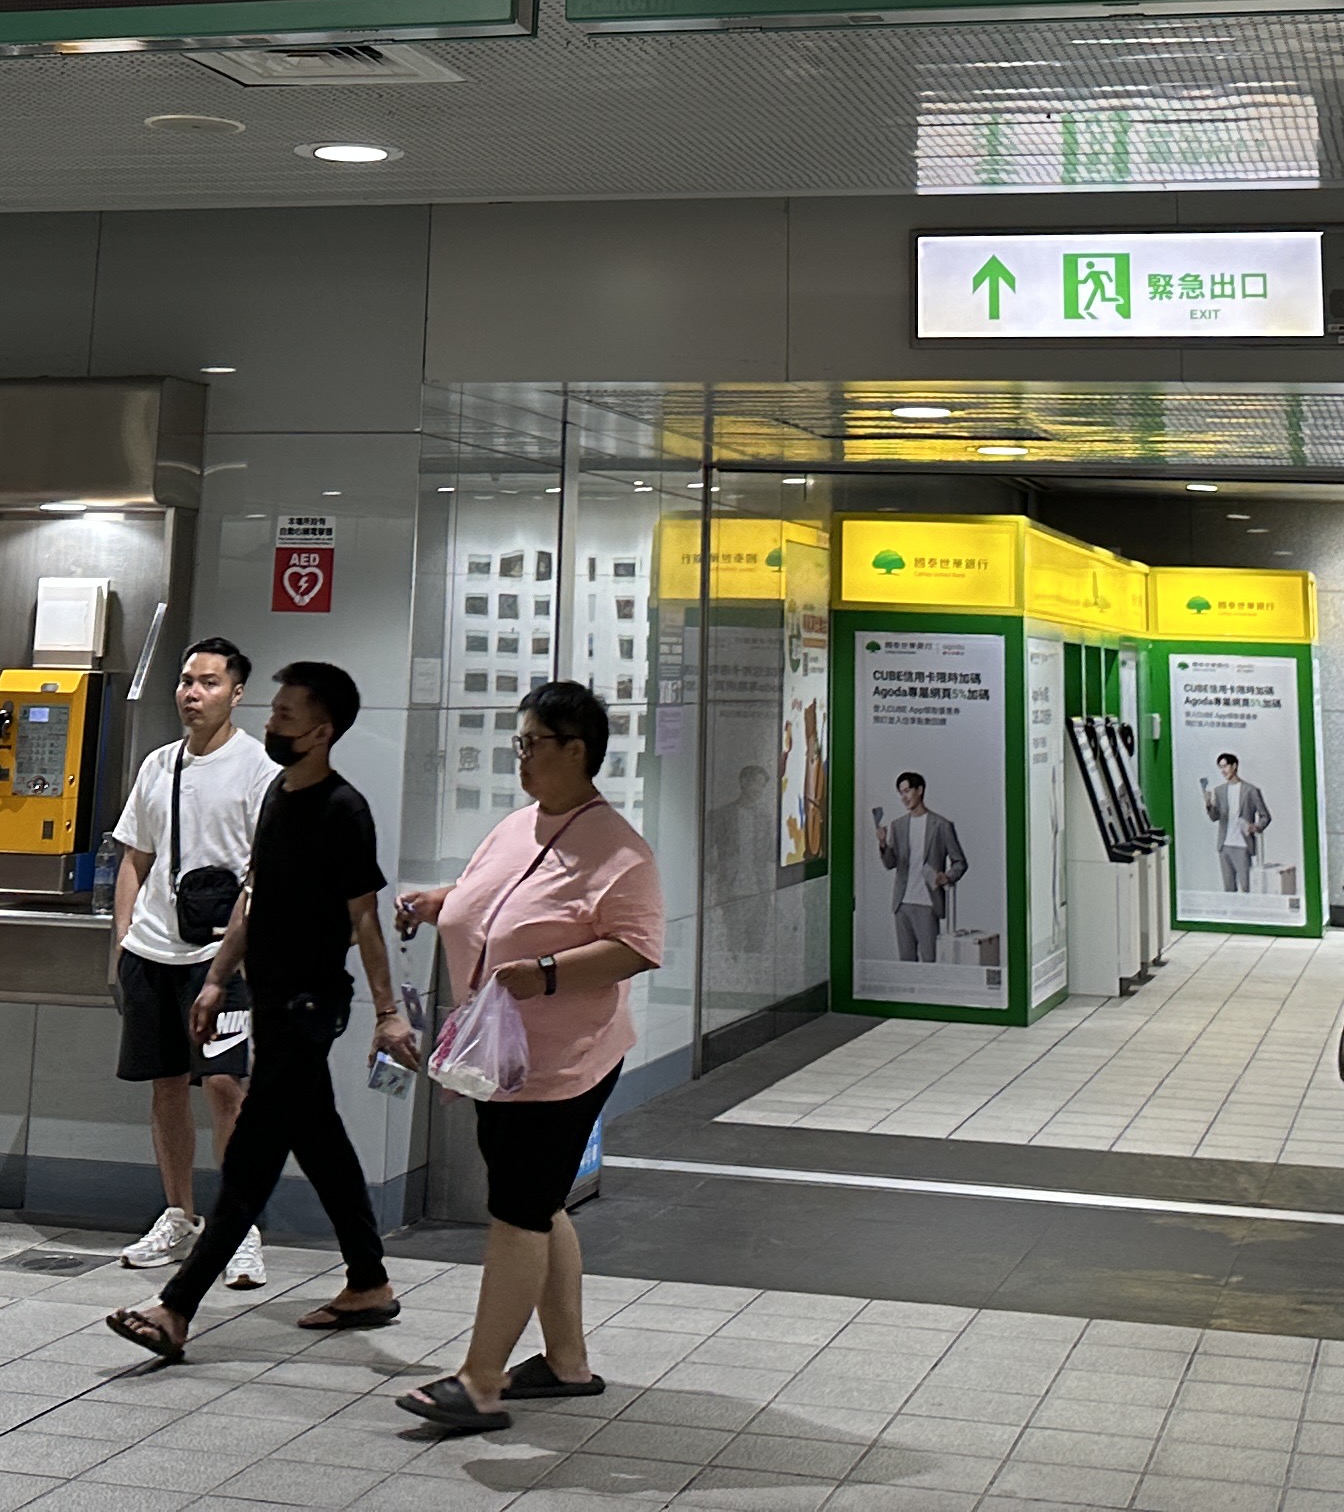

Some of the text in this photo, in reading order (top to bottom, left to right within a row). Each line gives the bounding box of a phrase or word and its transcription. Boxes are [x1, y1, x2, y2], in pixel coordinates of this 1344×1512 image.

[1148, 272, 1268, 300] 緊急出口
[1189, 308, 1221, 320] EXIT
[288, 553, 320, 566] AED
